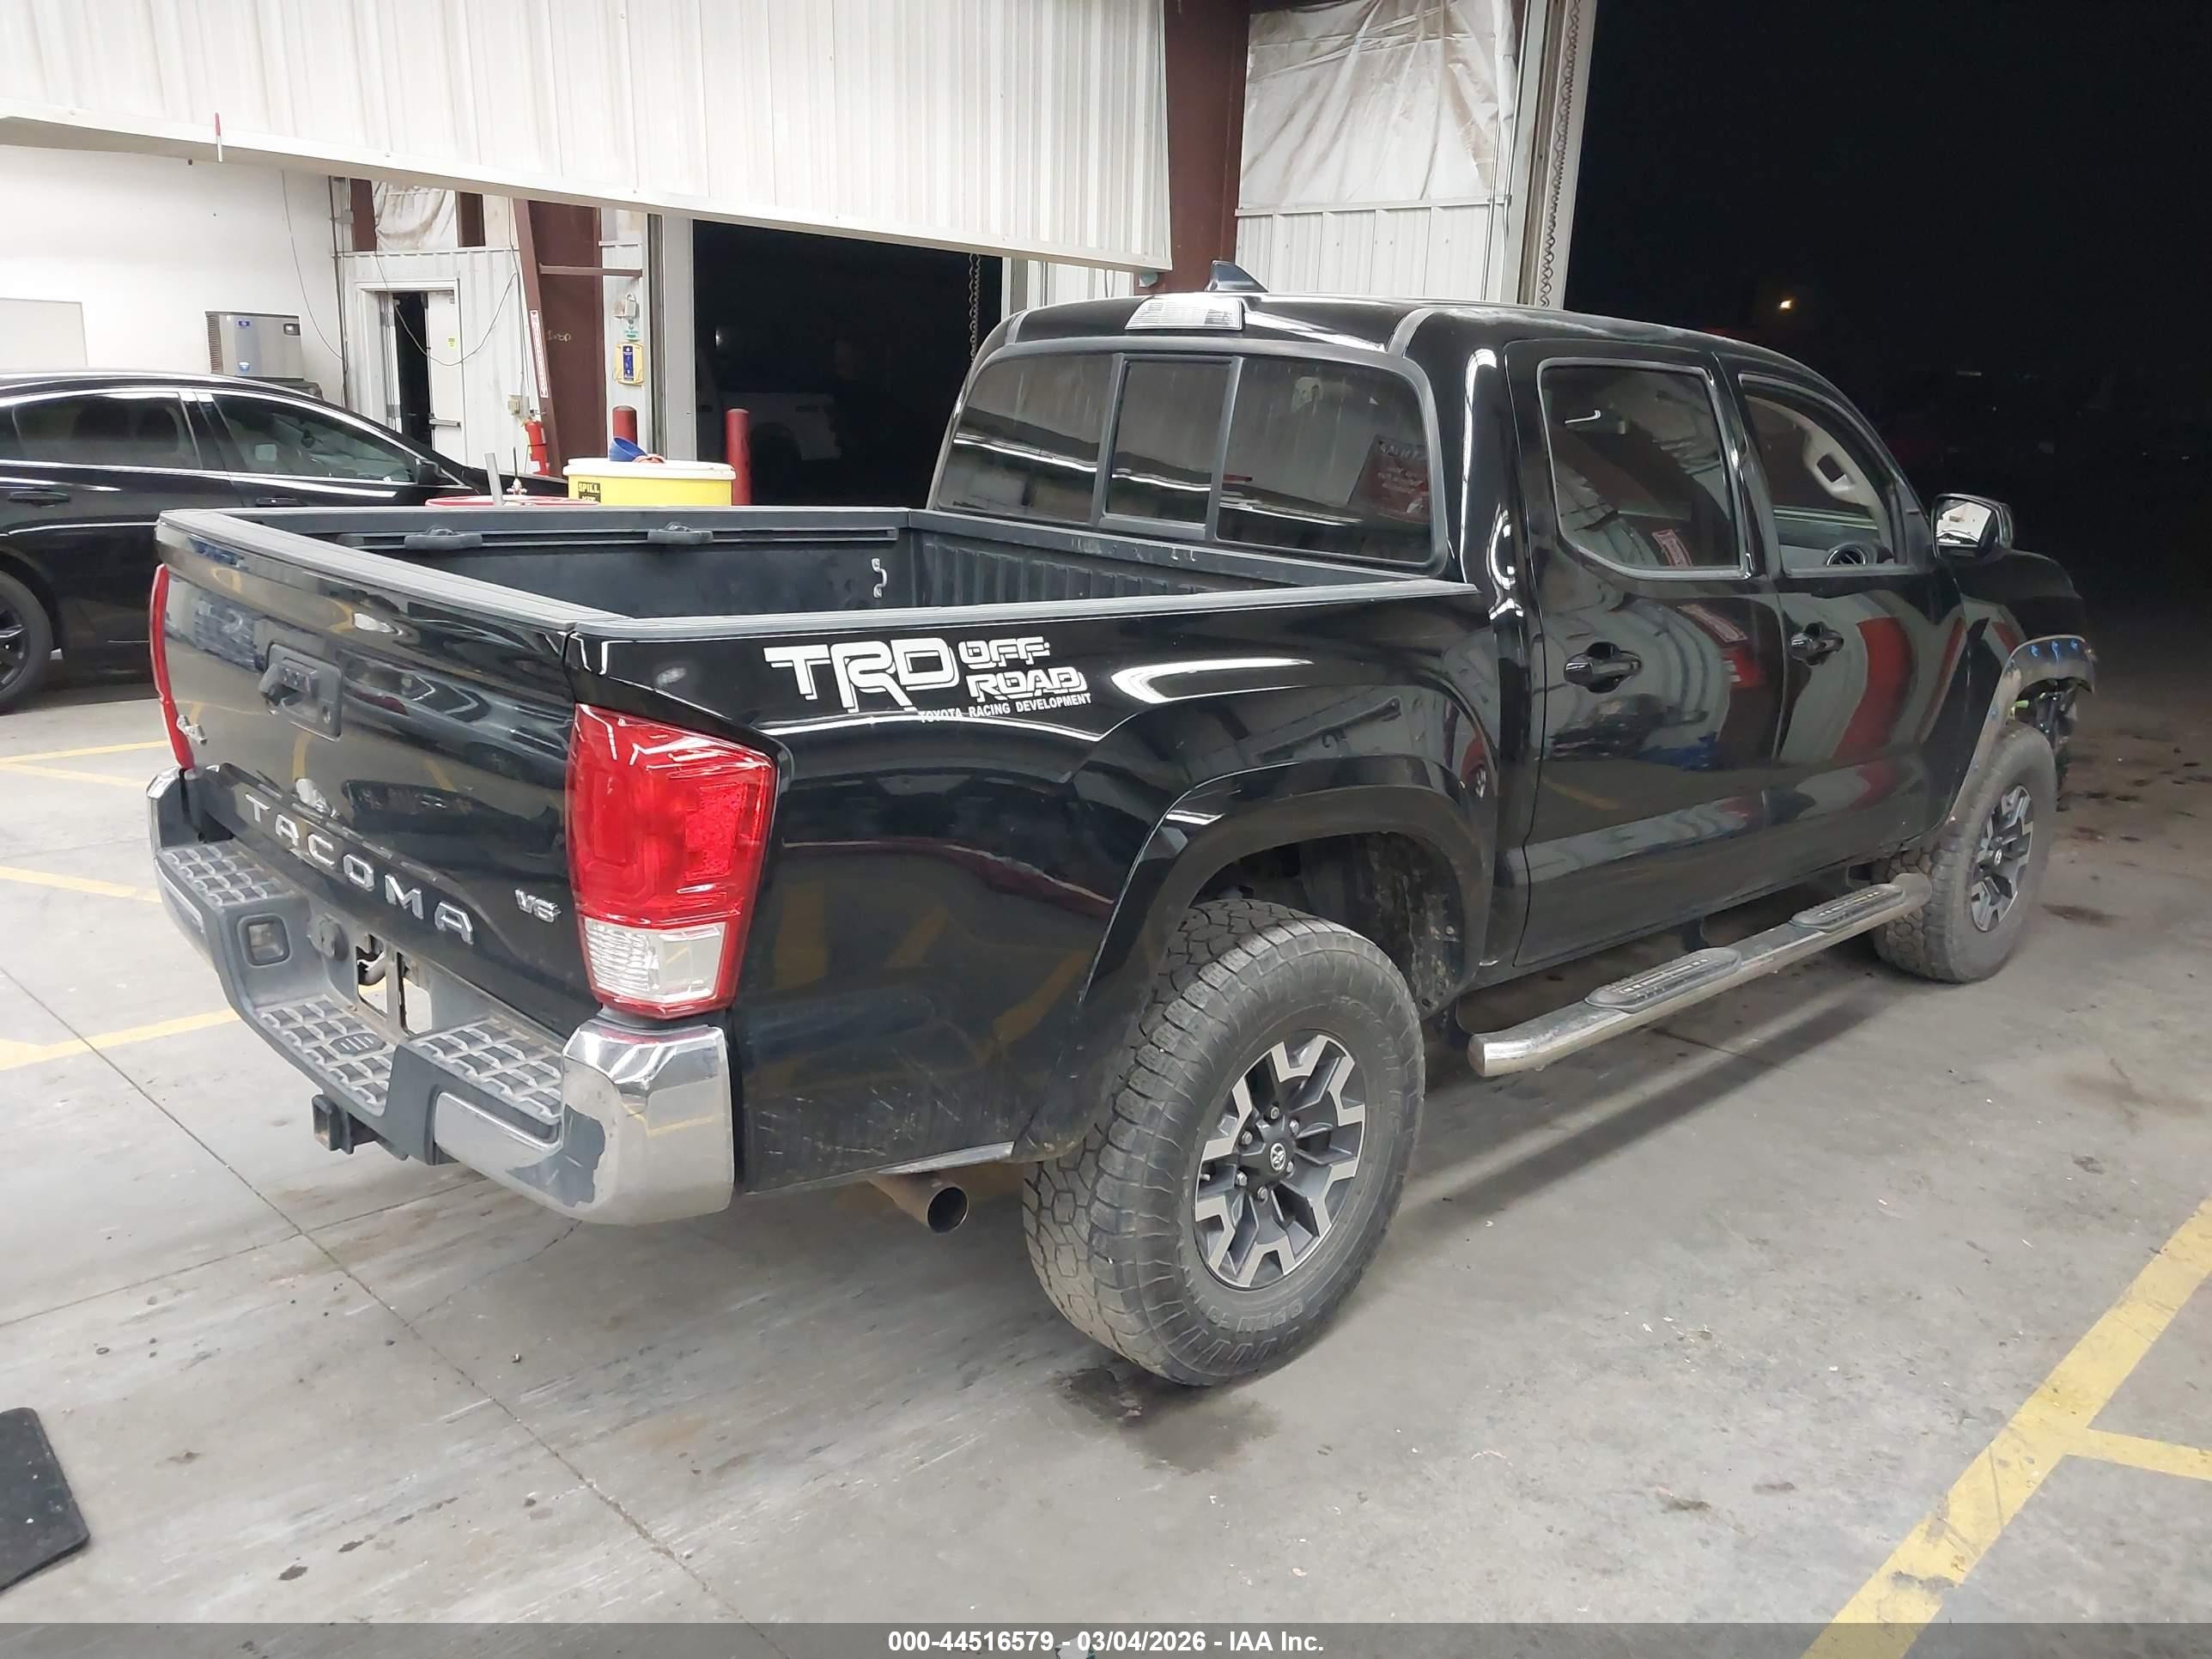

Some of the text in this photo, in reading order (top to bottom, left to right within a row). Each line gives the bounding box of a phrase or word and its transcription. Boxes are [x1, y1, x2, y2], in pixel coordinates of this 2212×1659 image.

[578, 483, 600, 494] SPILL
[957, 636, 1050, 670] OFF
[763, 638, 960, 714] TRD
[965, 666, 1087, 702] ROAD
[918, 692, 1092, 723] TOYOTA RACING DEVELOPMENT
[245, 793, 473, 945] TACOMA
[514, 887, 562, 923] V6
